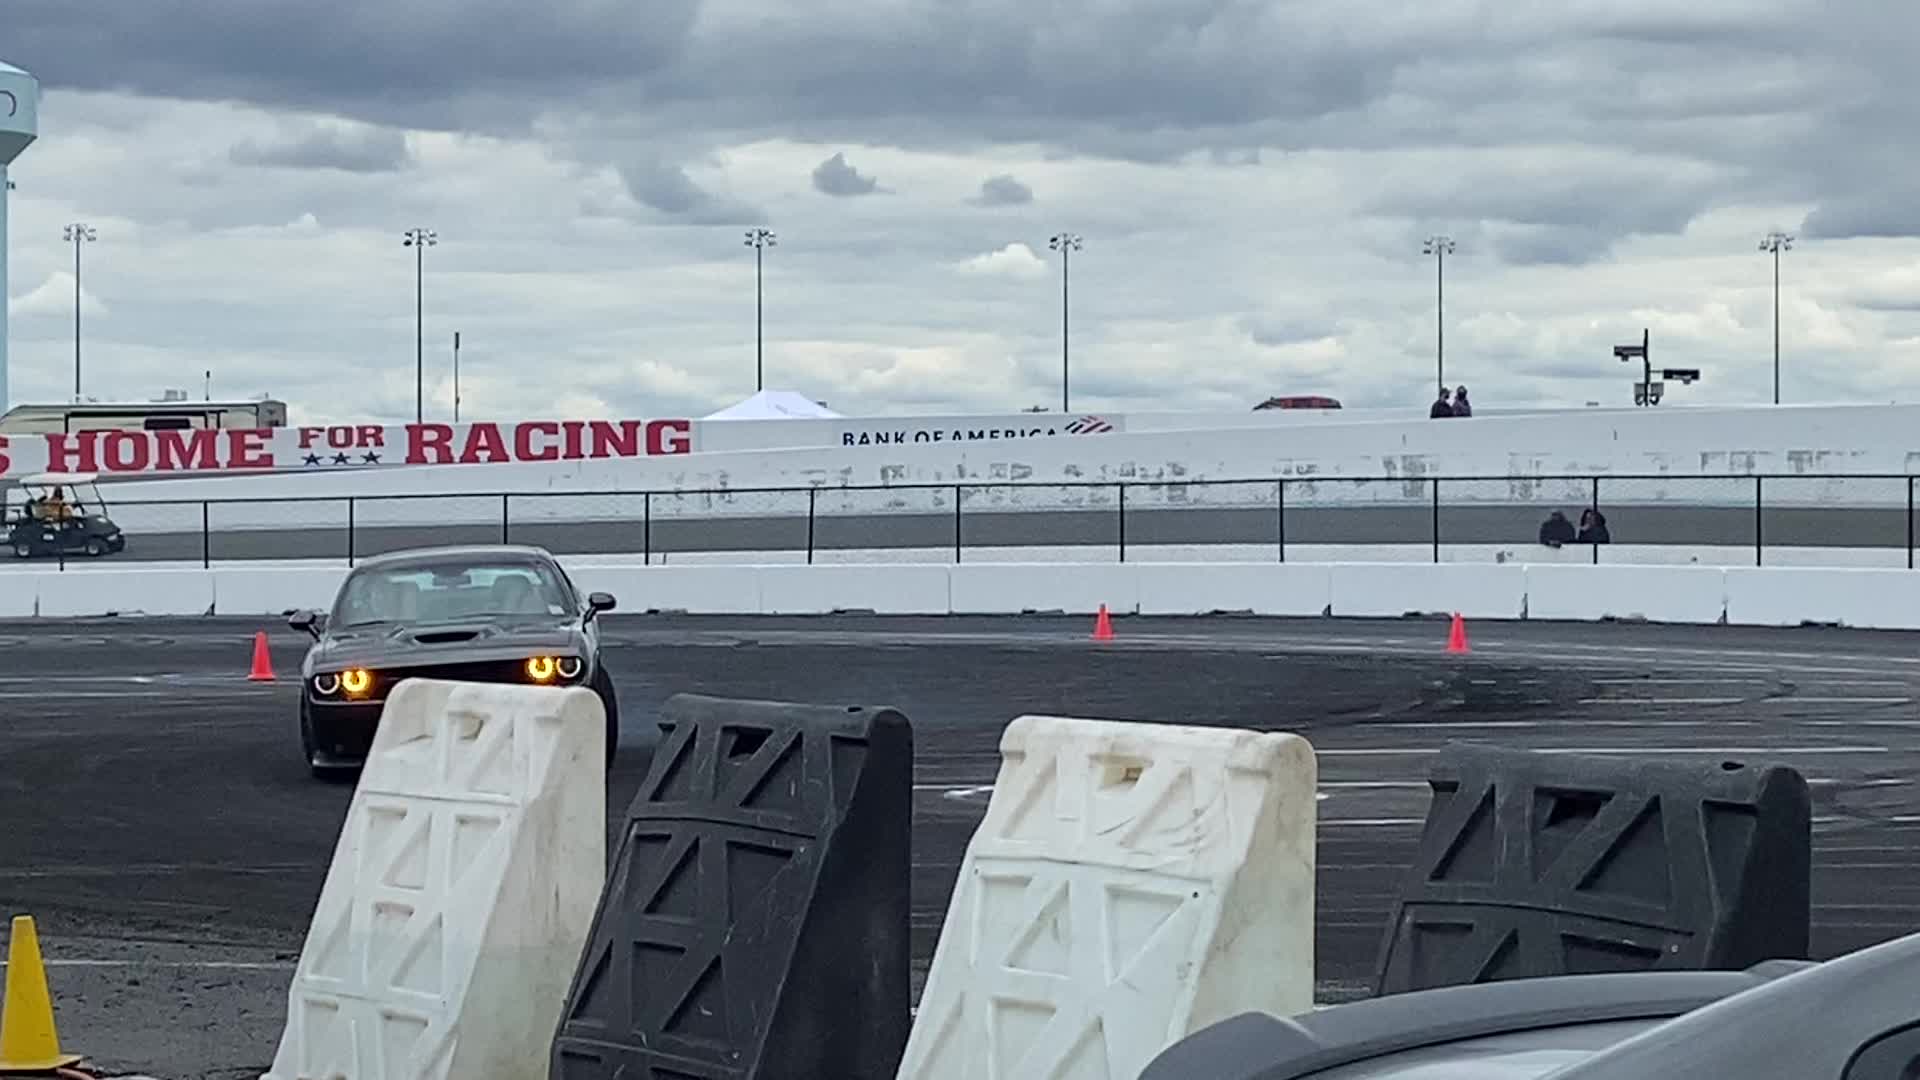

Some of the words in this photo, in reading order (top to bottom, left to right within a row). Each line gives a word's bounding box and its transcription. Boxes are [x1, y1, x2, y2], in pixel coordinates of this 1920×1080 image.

[46, 428, 274, 472] HOME
[298, 425, 384, 448] FOR
[405, 420, 691, 464] RACING
[843, 432, 905, 446] BANK
